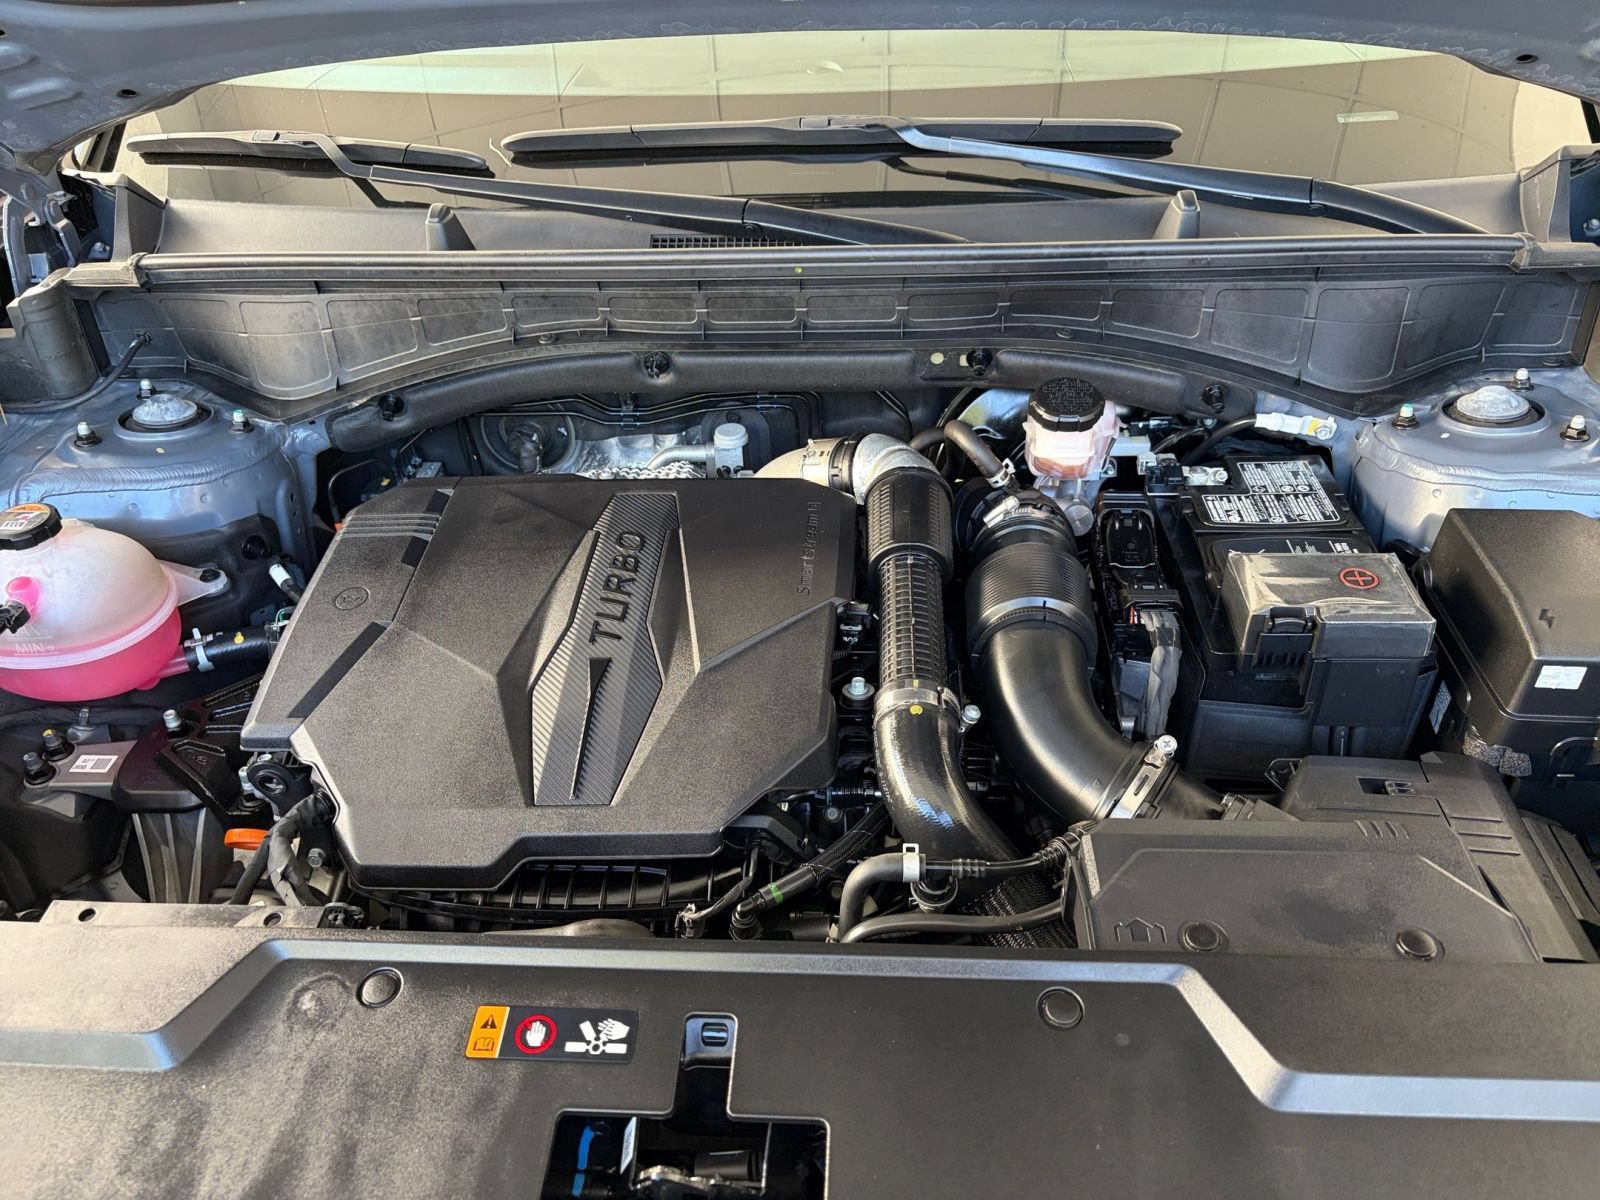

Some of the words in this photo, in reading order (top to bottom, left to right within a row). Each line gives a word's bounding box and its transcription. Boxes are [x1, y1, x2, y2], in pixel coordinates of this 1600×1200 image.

[588, 531, 645, 644] TURBO
[796, 513, 819, 596] Smartstream
[14, 642, 46, 654] MIN
